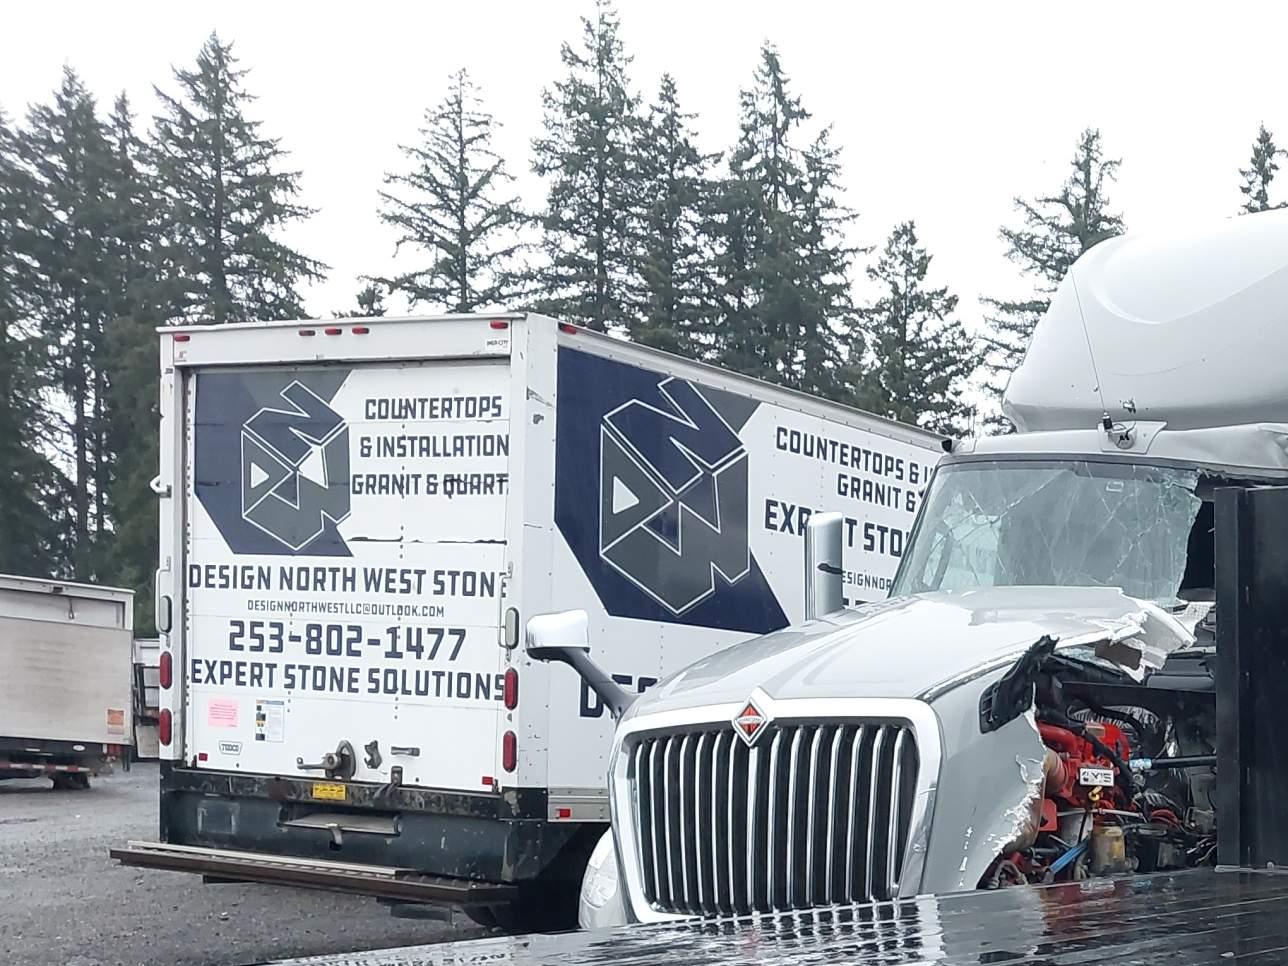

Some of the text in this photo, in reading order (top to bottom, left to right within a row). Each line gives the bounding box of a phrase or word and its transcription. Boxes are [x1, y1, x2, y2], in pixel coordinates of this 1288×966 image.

[365, 396, 502, 420] COUNTERTOPS
[360, 434, 510, 458] & INSTALLATION
[776, 426, 904, 481] COUNTERTOPS
[909, 462, 920, 484] &
[351, 473, 510, 499] GRANIT & QUART
[837, 473, 917, 513] GRANIT &
[863, 522, 910, 558] STO
[189, 564, 271, 591] DESIGN
[279, 566, 356, 592] NORTH
[363, 567, 427, 595] WEST
[247, 600, 445, 618] DESIGNNORTHWESTLLC@OUTLOOK.COM
[229, 620, 467, 661] 253-802-1477
[191, 658, 505, 701] EXPERT STONE SOLUTIONS
